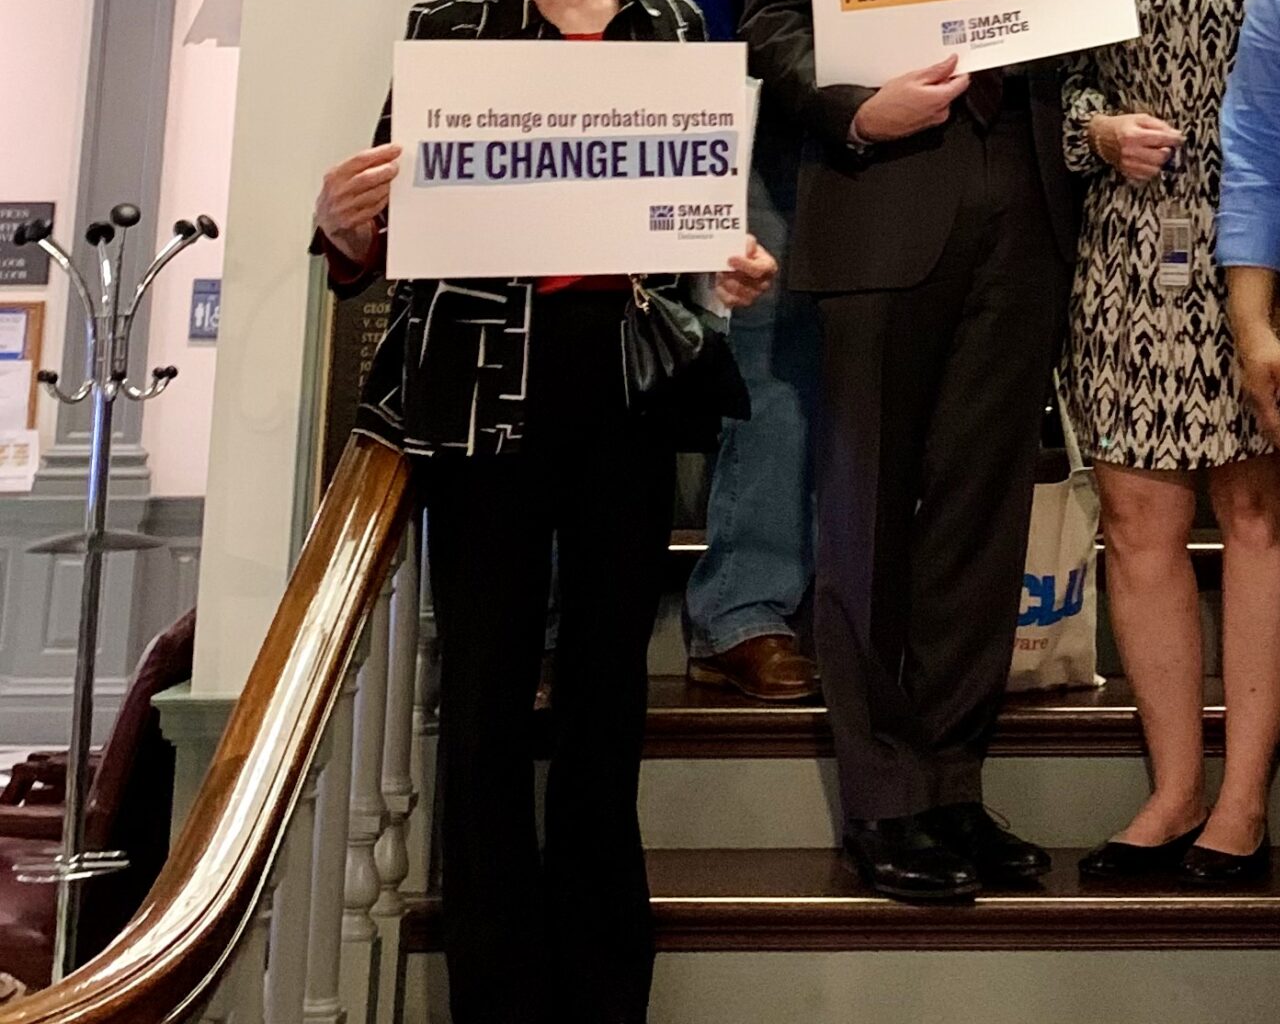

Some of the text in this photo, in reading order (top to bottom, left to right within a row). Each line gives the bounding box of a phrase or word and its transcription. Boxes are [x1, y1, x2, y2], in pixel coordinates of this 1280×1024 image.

[968, 10, 1022, 30] SMART
[970, 21, 1030, 42] JUSTICE
[427, 108, 734, 133] If we change our probation system
[422, 138, 738, 180] WE CHANGE LIVES.
[678, 204, 734, 216] SMART
[678, 218, 740, 230] JUSTICE
[1017, 562, 1087, 626] CLU
